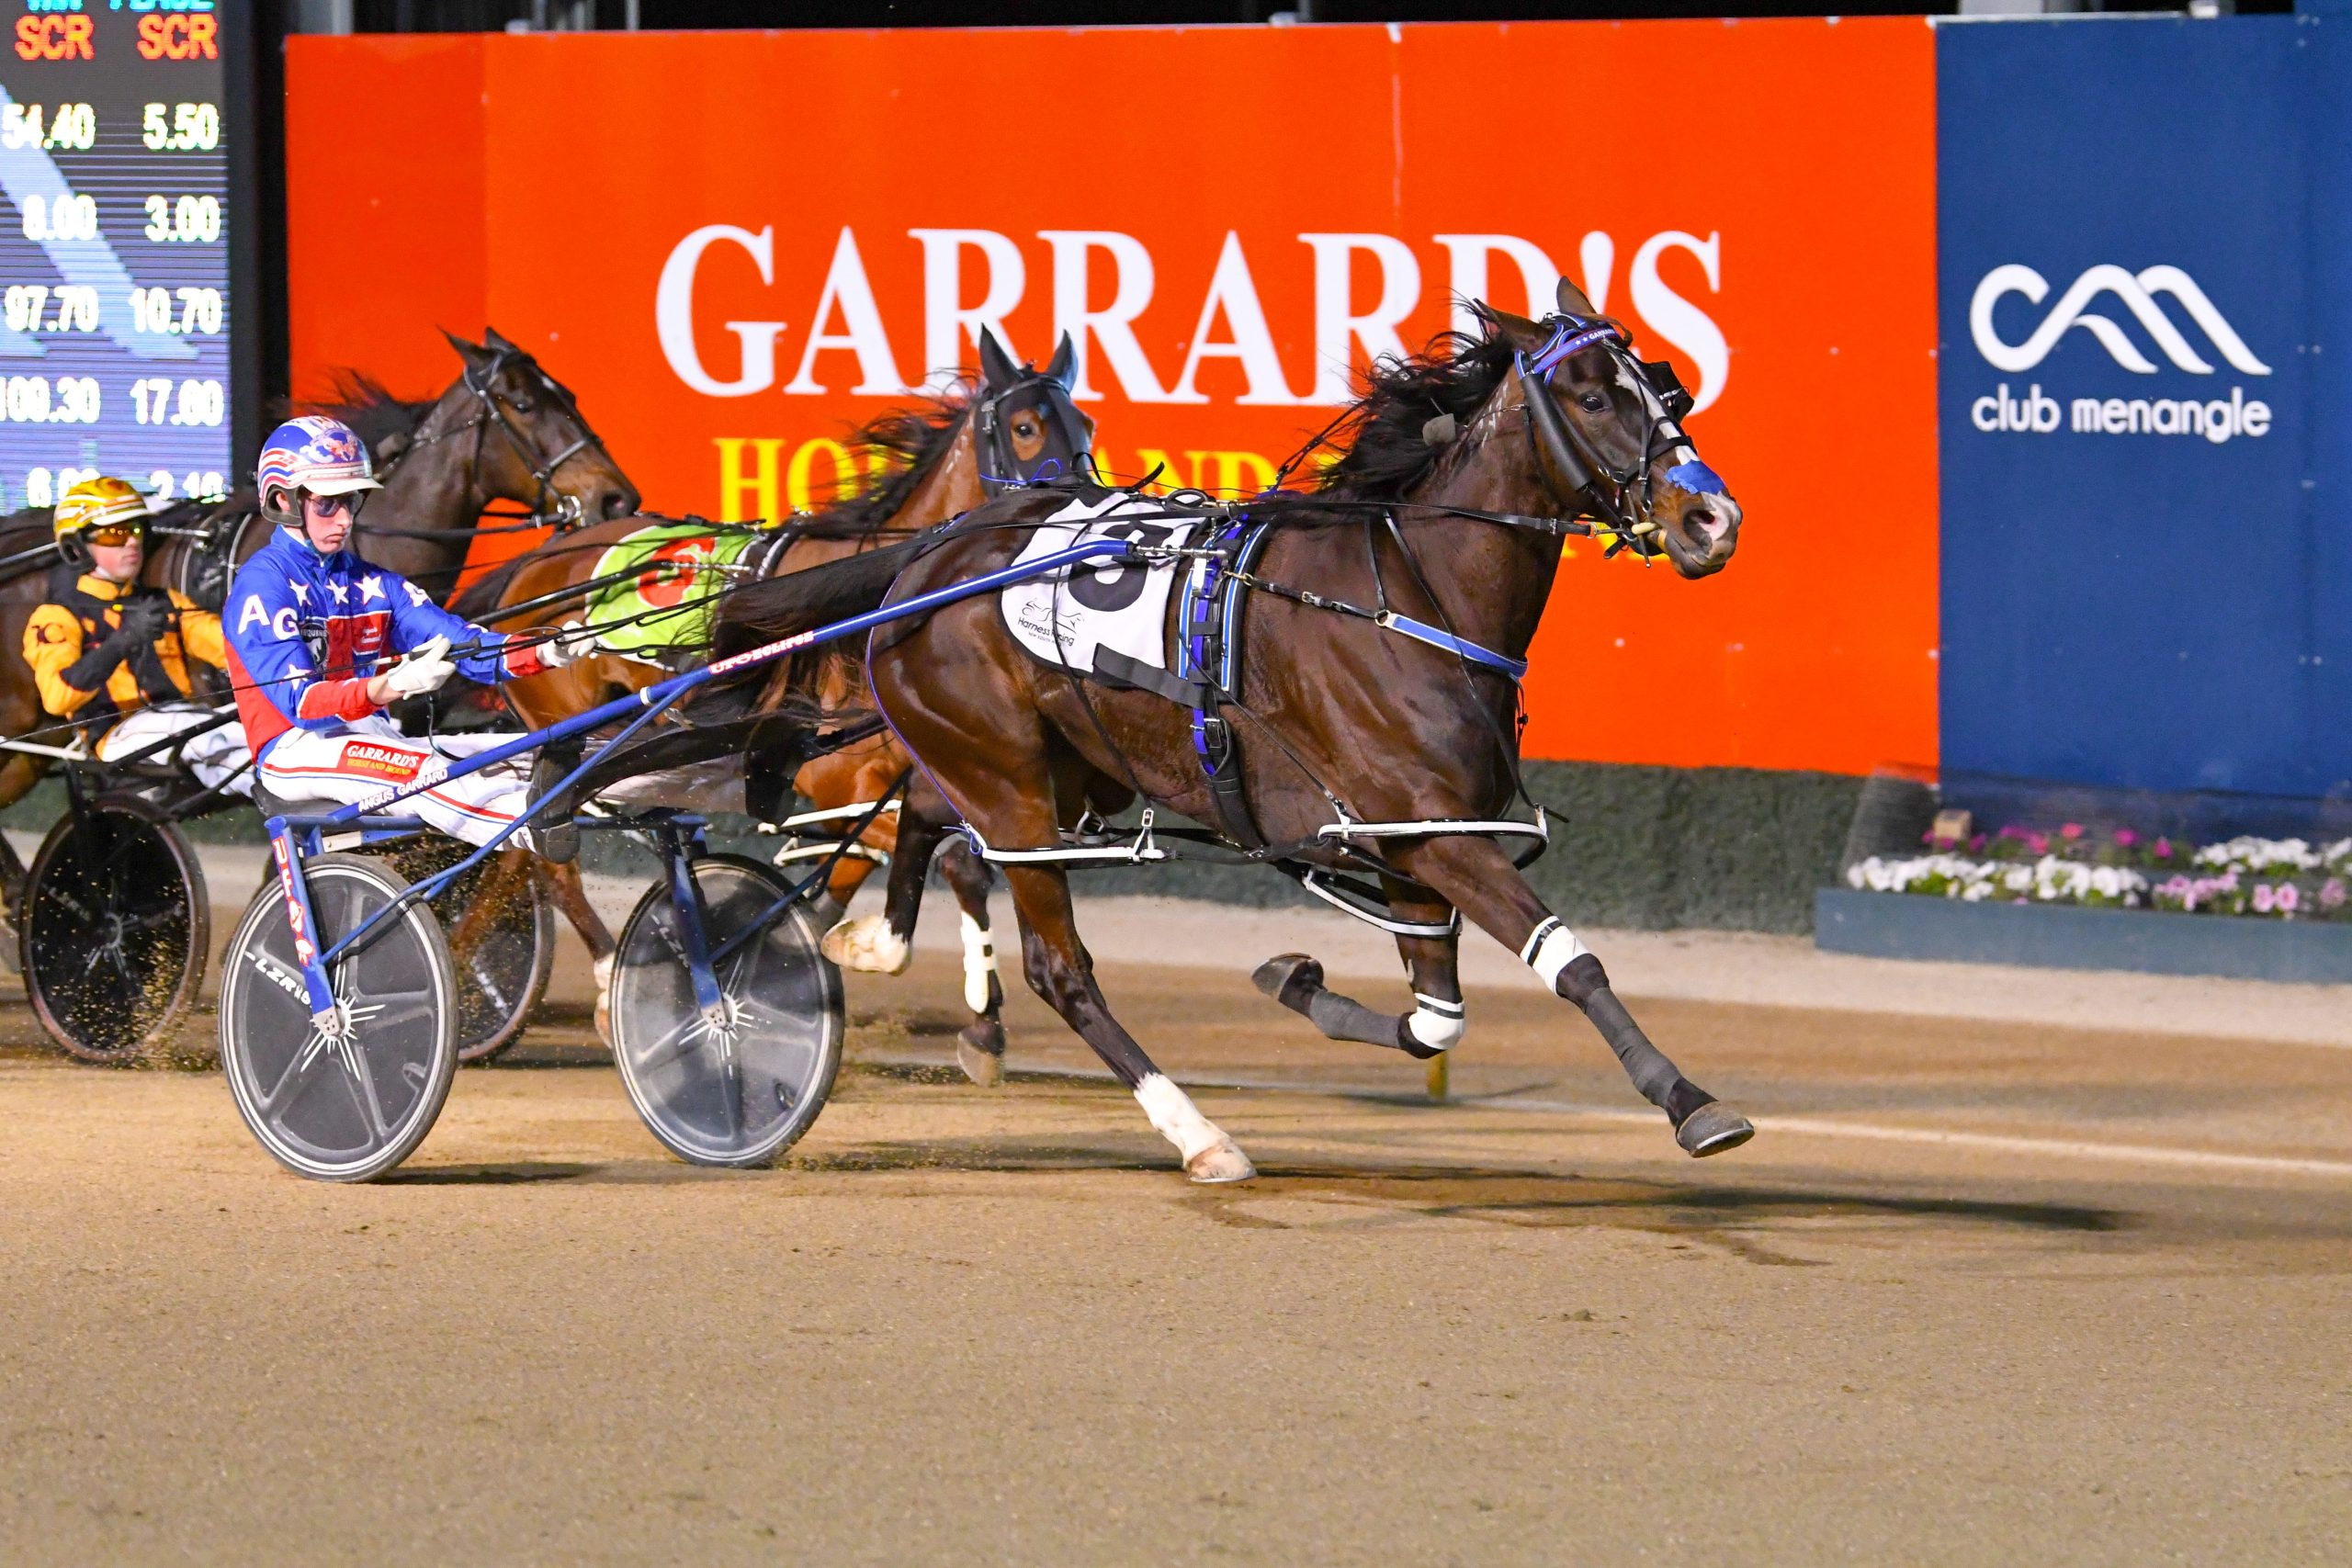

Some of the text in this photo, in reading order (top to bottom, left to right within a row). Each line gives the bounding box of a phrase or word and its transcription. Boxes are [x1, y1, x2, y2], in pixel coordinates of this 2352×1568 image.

[16, 14, 218, 60] SCR SCR
[2, 104, 220, 150] 54.40 5.50
[145, 196, 220, 242] 3.00
[5, 286, 222, 333] 97.70 10.70
[656, 224, 1731, 416] GARRARD'S
[1972, 383, 2272, 444] club menangle
[1018, 617, 1051, 637] Harness
[347, 745, 420, 768] GARRARD'S
[358, 768, 448, 813] ANGUS GARRARD
